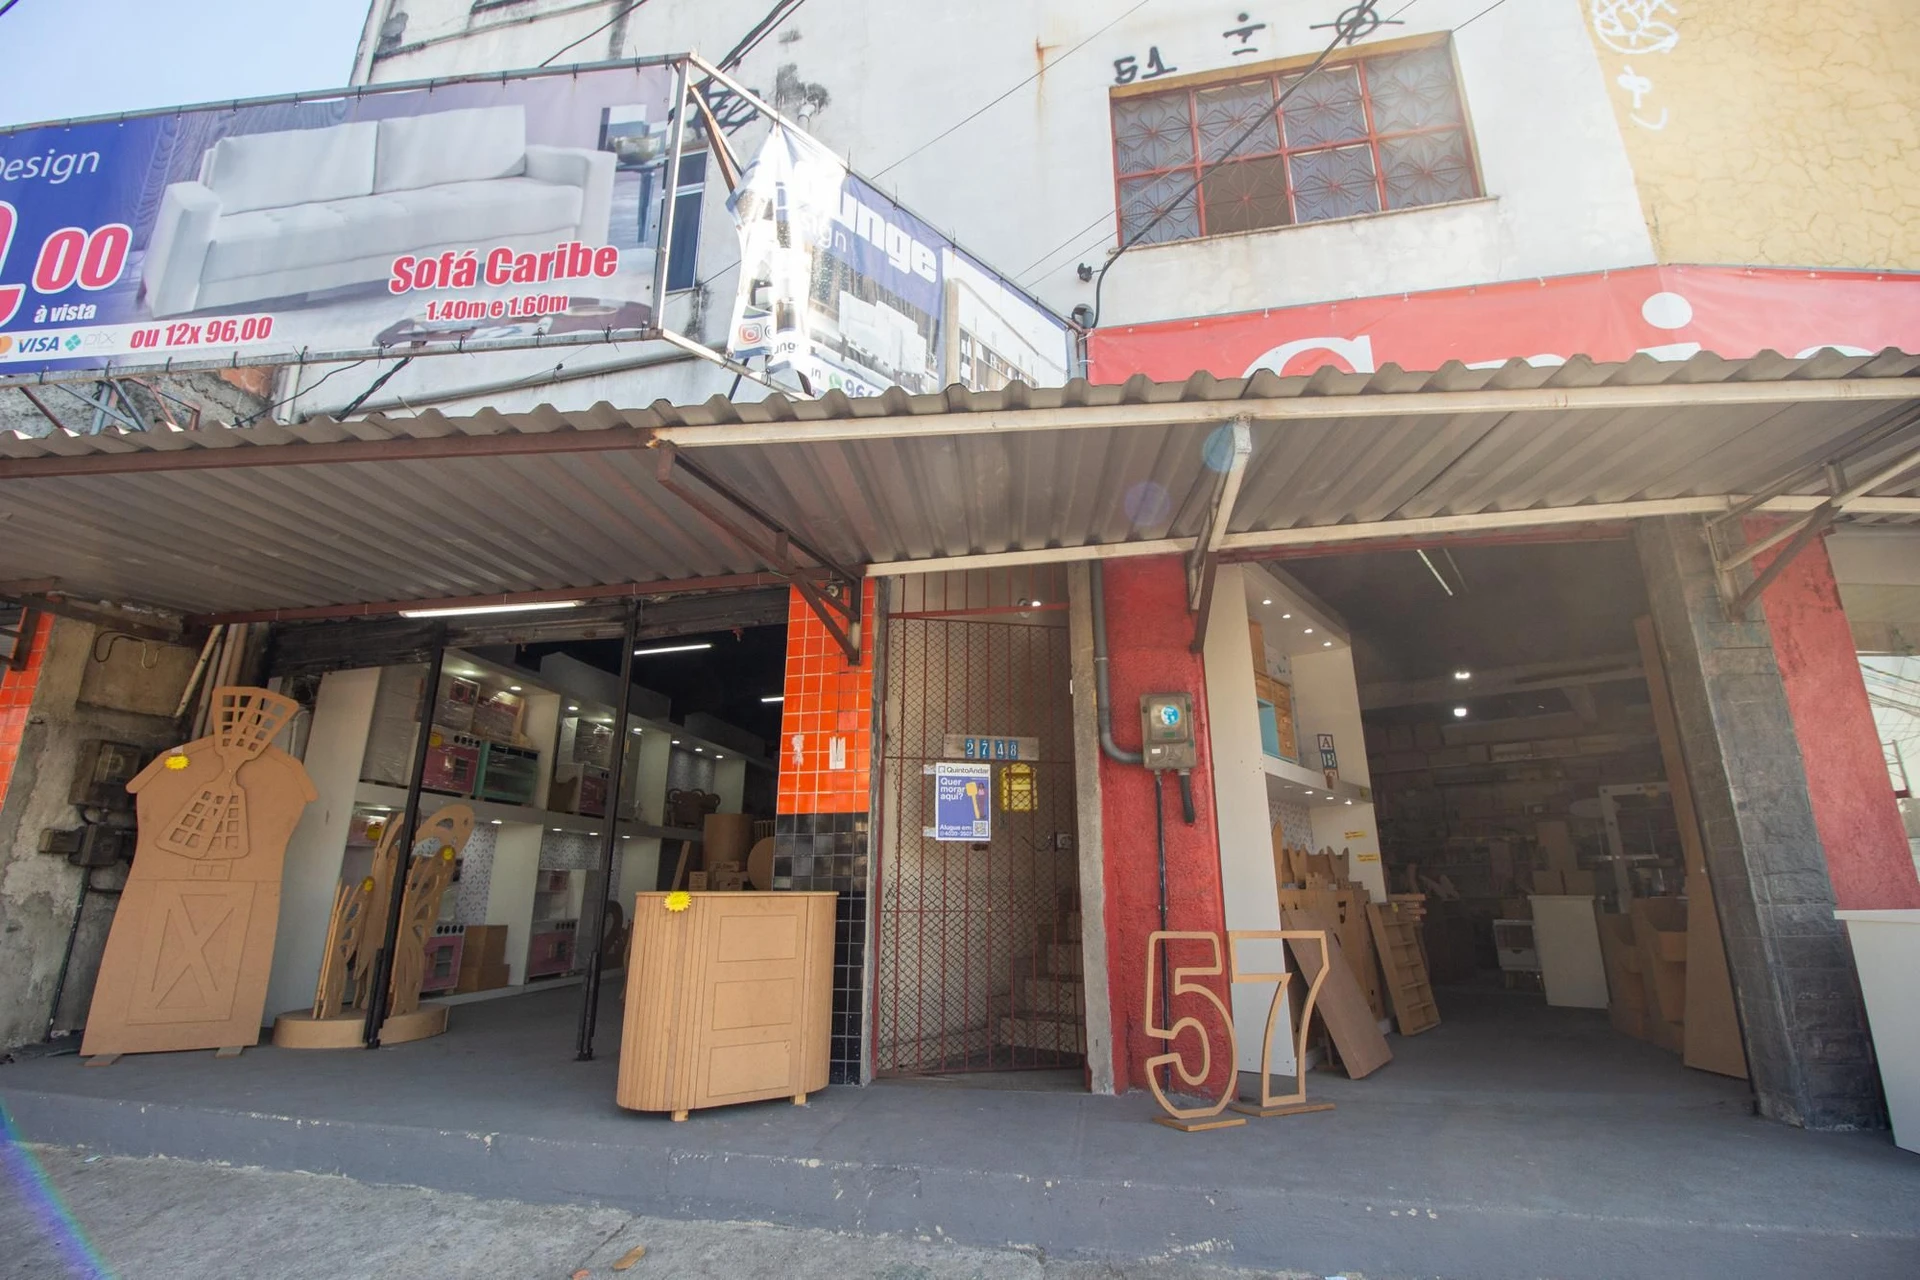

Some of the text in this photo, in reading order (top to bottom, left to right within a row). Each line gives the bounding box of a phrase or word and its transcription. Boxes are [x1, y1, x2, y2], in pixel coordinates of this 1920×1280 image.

[1113, 46, 1178, 84] 51
[389, 241, 619, 295] Sofá Caribe
[34, 303, 97, 323] à vista
[427, 293, 568, 321] 1.40m e 1.60m
[130, 316, 274, 349] ou 12x 96,00
[18, 336, 60, 353] VISA
[967, 742, 1017, 756] 2748
[1322, 737, 1331, 748] A
[1322, 752, 1336, 767] B
[946, 766, 989, 774] QuintoAndar
[940, 777, 962, 786] Quer
[940, 792, 964, 802] aqui?
[1145, 930, 1331, 1119] 57
